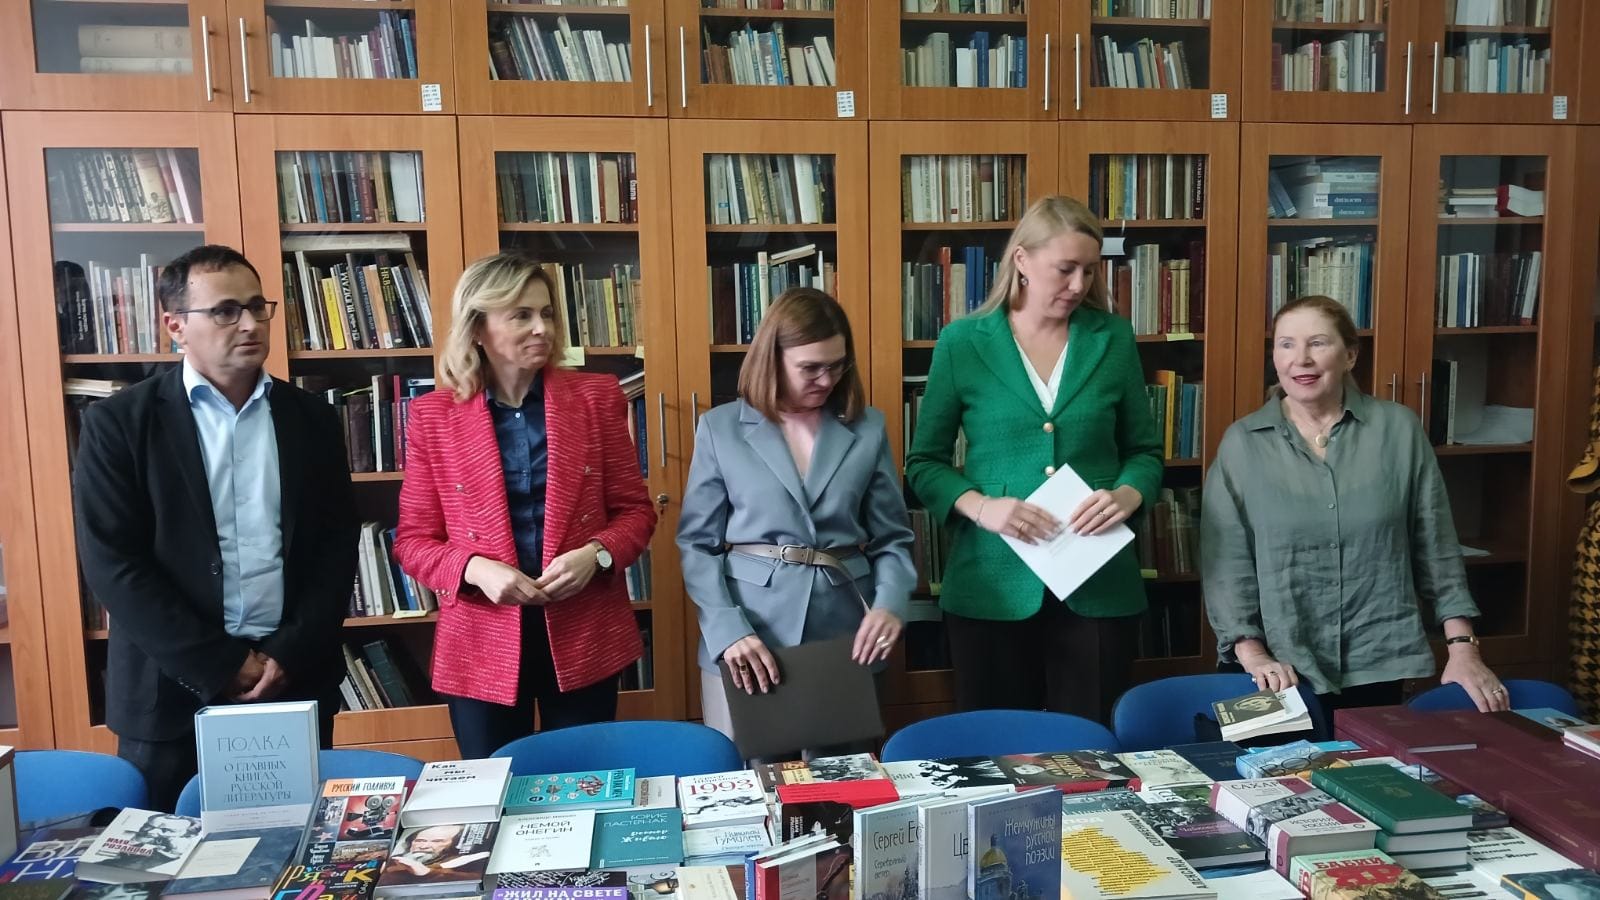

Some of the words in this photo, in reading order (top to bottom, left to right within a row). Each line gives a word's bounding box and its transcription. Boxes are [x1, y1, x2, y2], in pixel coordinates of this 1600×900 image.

[217, 734, 291, 753] ПОЛКА
[224, 762, 234, 772] О
[236, 760, 287, 772] ГЛАВНЫХ
[431, 762, 456, 770] Как
[235, 771, 278, 782] КНИГАХ
[230, 780, 283, 792] РУССКОЙ
[331, 782, 361, 793] РУССКИЙ
[362, 780, 395, 792] ГОЛЛИВУД
[690, 779, 754, 795] 1993
[224, 791, 292, 804] ЛИТЕРАТУРЫ
[631, 812, 668, 820] БОРИС
[520, 821, 571, 829] НЕМОЙ
[603, 818, 668, 828] ПАСТЕРНАК
[515, 827, 573, 836] ОНЕГИН
[873, 828, 905, 852] Сергей
[548, 889, 569, 898] НА
[572, 888, 622, 897] СВЕТЕ
